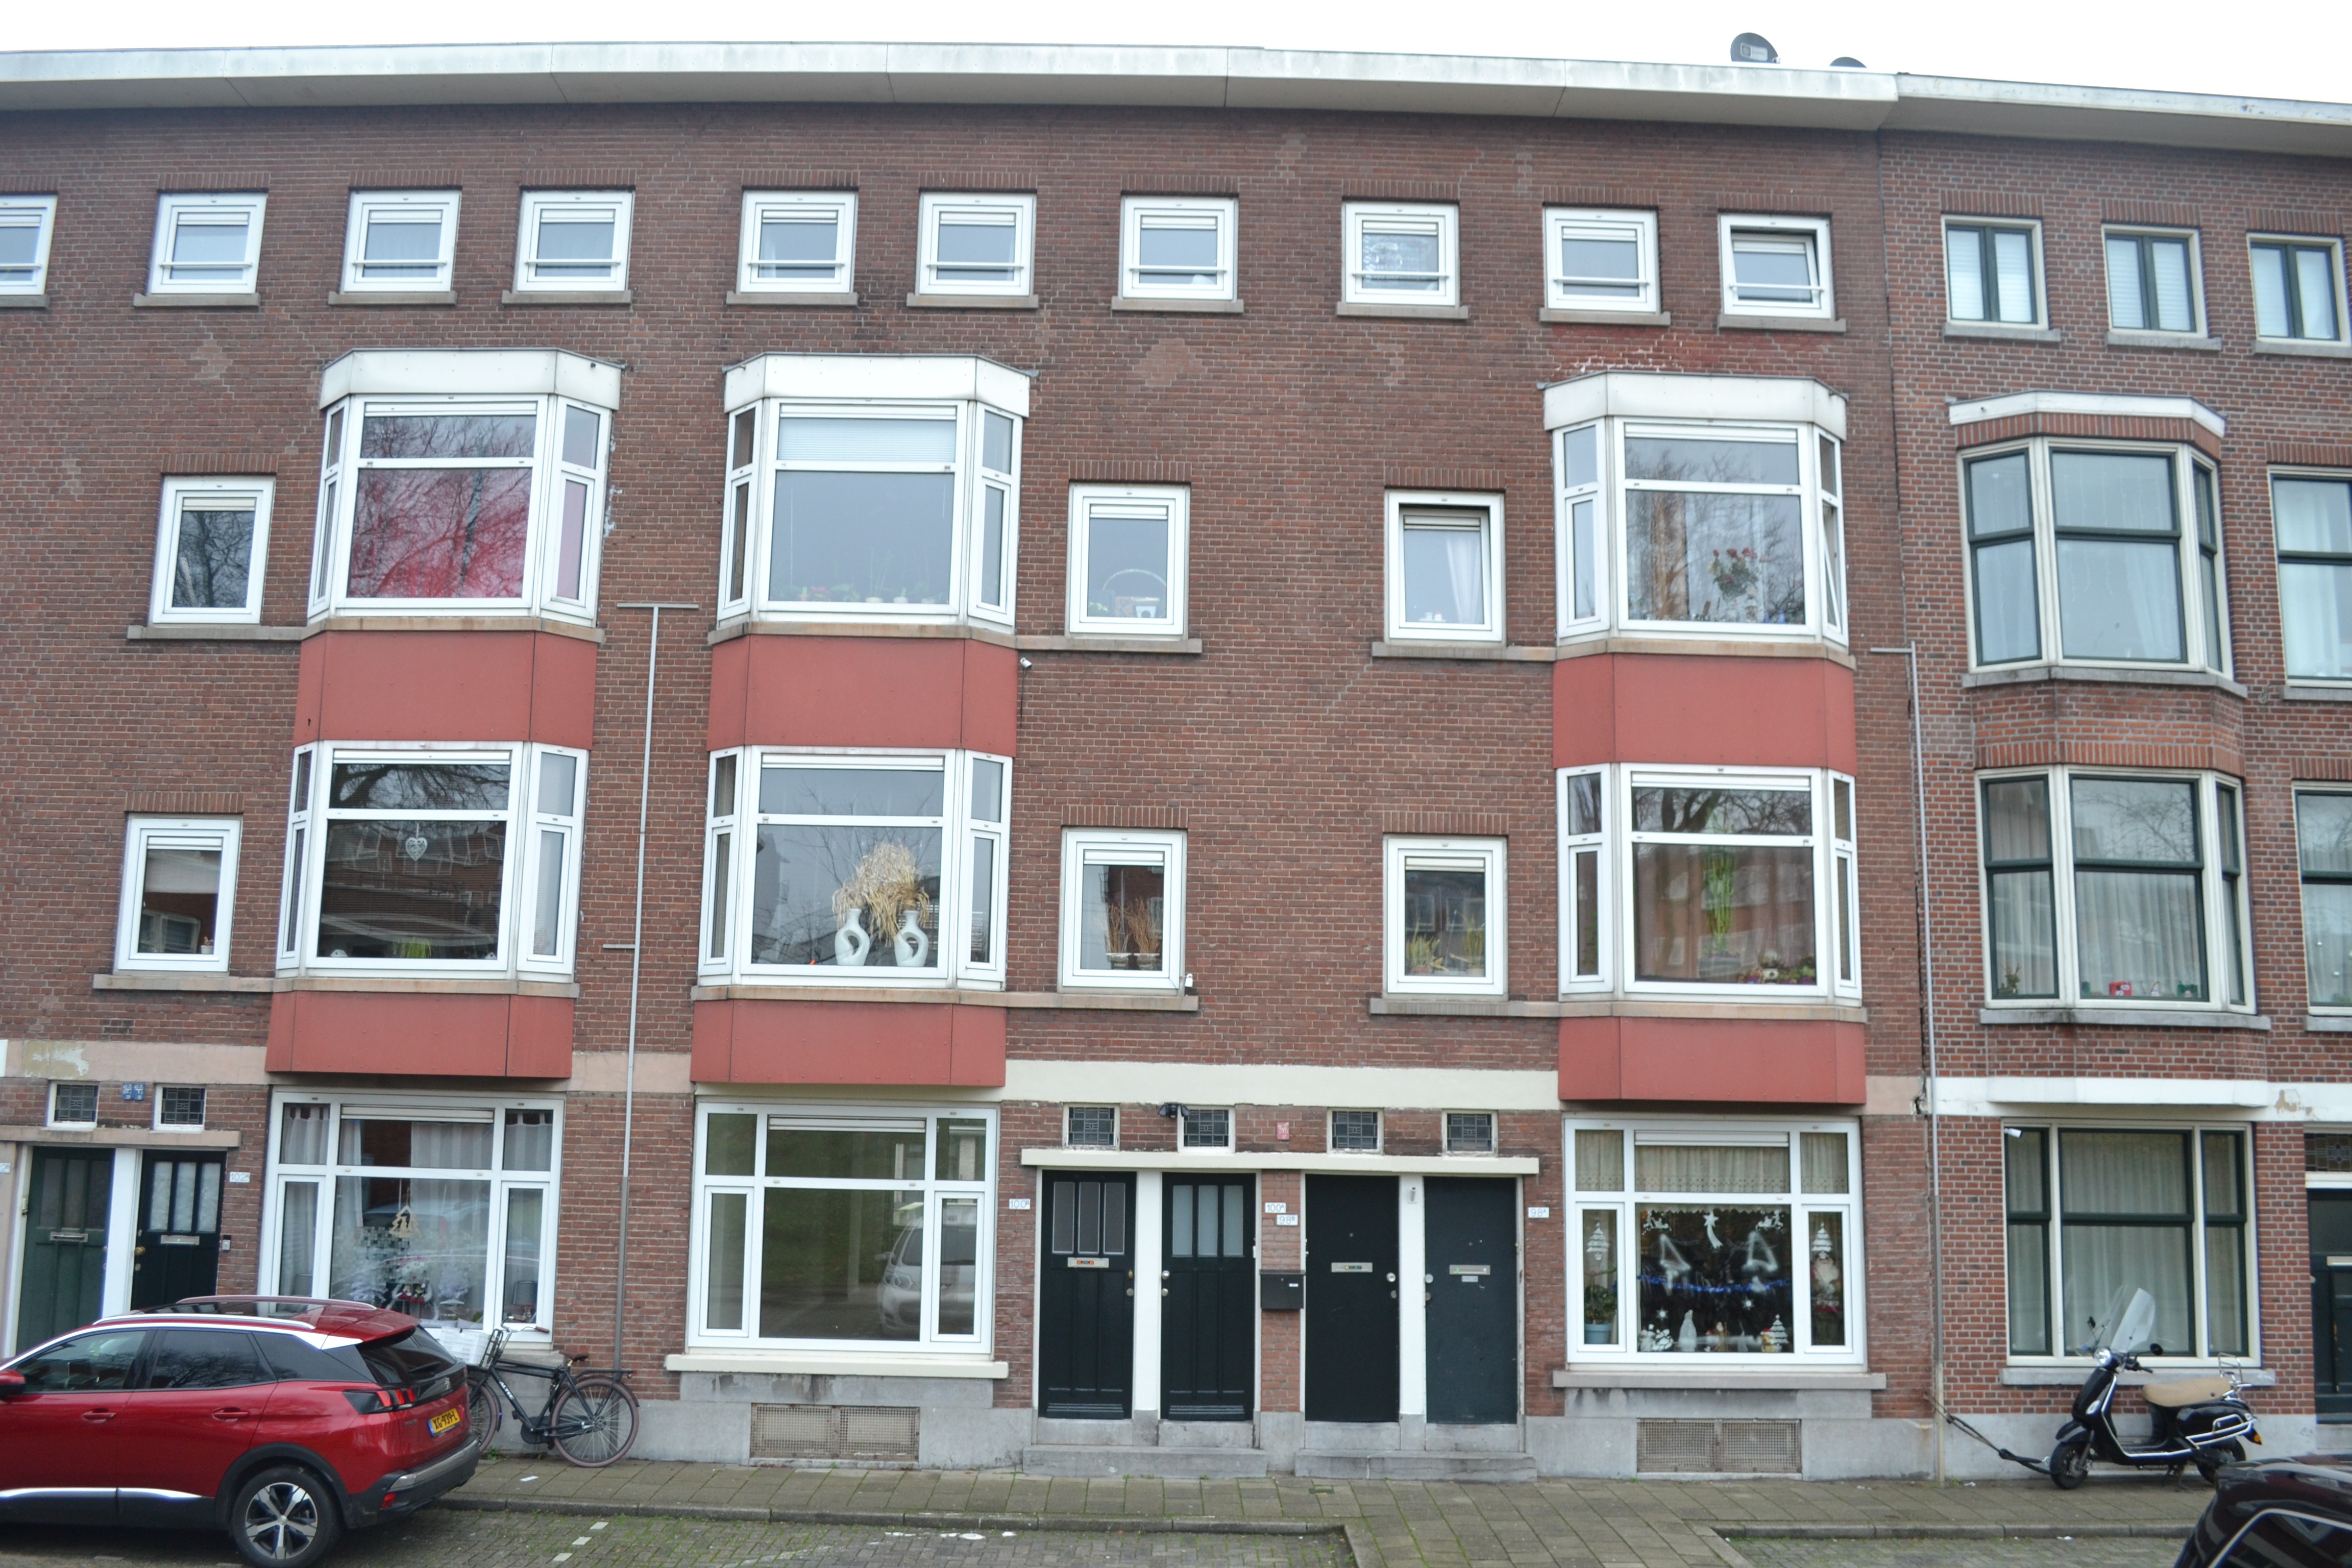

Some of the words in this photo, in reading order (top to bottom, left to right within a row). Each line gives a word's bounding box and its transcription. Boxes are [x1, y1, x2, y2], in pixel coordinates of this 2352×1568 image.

[231, 1173, 250, 1181] 102A
[1267, 1204, 1285, 1212] 100A
[1531, 1208, 1547, 1217] 98A
[1279, 1216, 1295, 1224] 98B
[432, 1411, 458, 1430] XG-939-L
